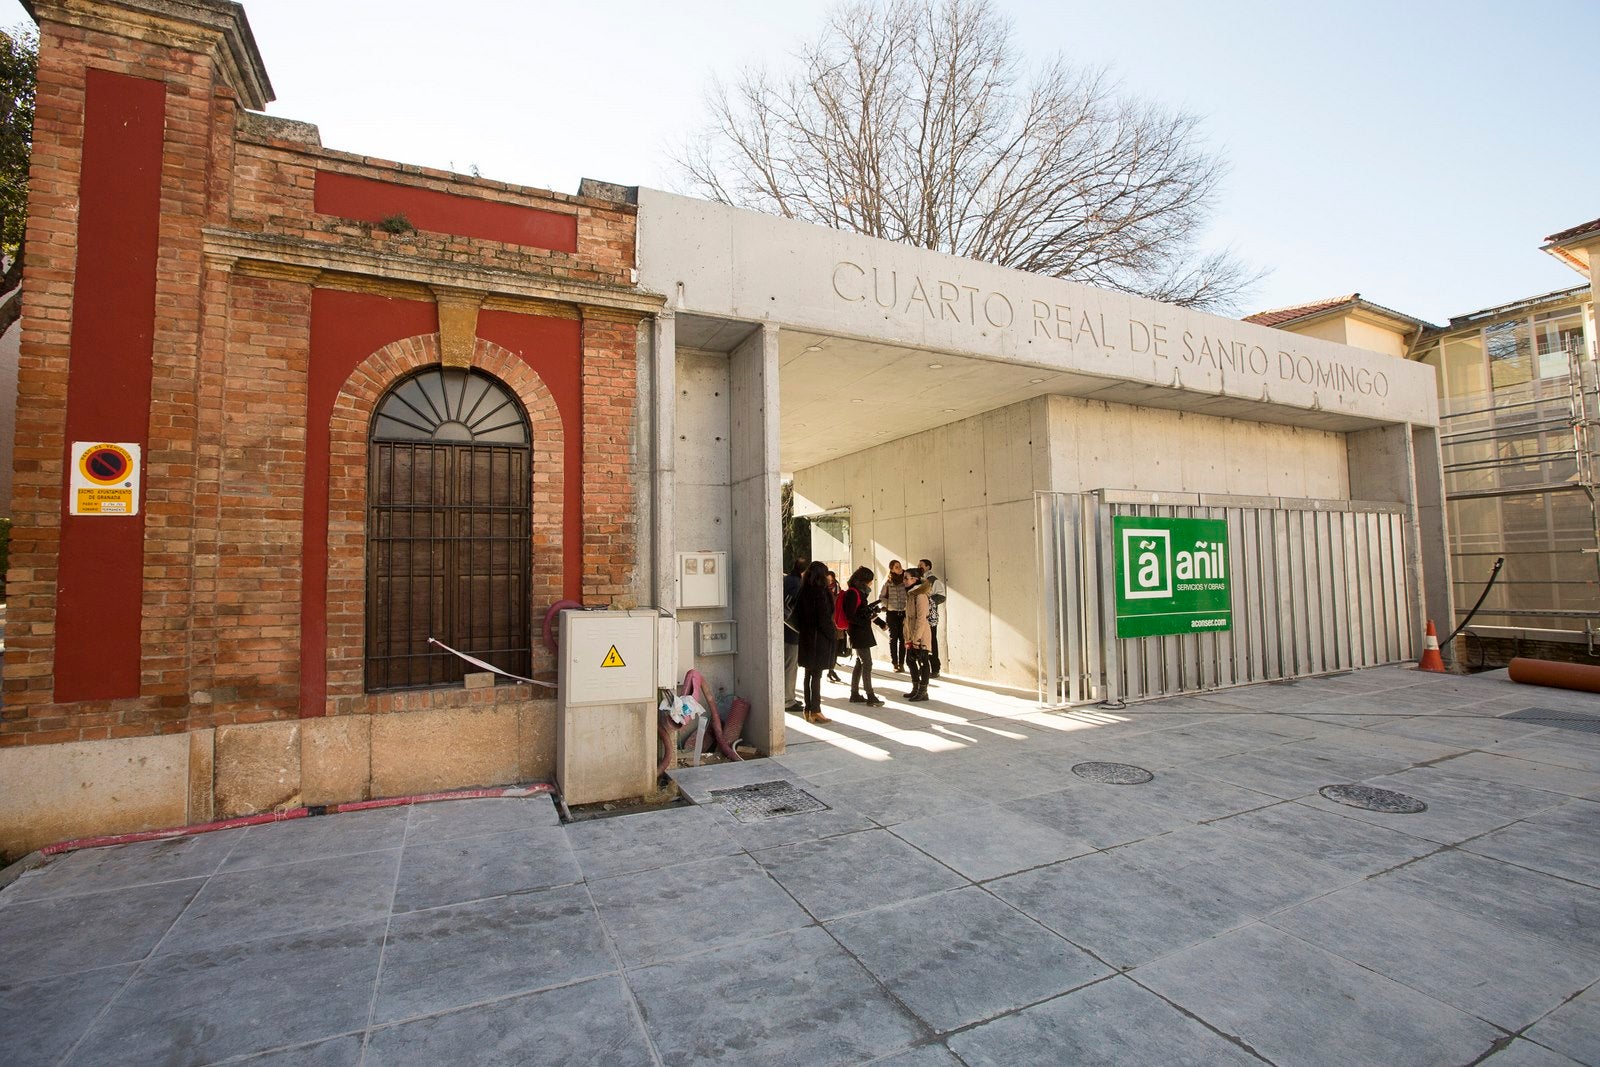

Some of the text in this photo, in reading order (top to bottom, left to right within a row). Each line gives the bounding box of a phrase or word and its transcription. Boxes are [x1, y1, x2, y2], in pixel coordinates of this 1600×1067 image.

[832, 261, 1388, 398] CUARTO REAL DE SANTO DOMINGO
[1176, 541, 1224, 580] añil
[1176, 583, 1204, 591] SERVICIOS
